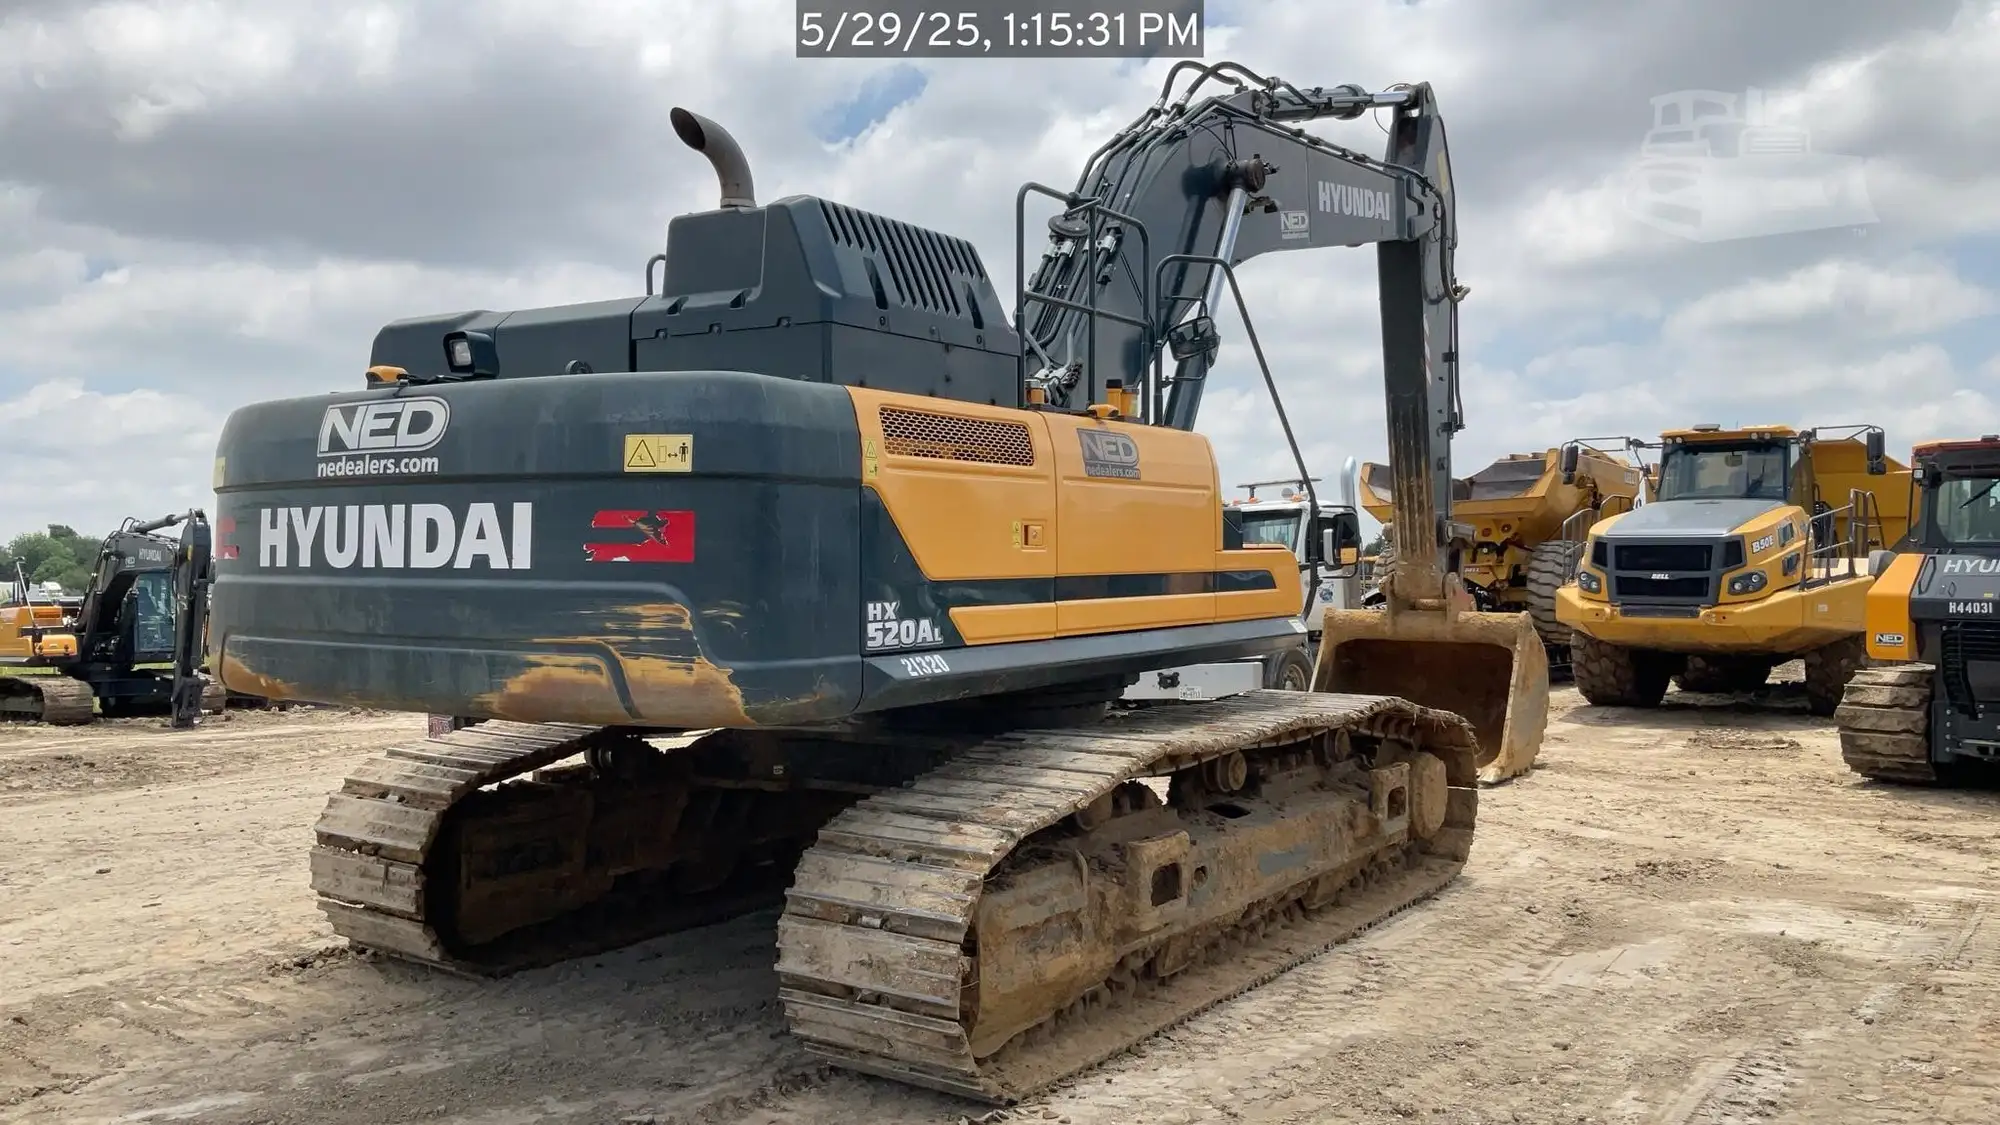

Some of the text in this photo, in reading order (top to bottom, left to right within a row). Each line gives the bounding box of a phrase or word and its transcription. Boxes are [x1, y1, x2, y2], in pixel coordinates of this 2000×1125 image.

[1318, 181, 1390, 221] HYUNDAI
[1280, 211, 1309, 232] NED
[319, 398, 449, 456] NED
[1079, 432, 1138, 463] NED
[316, 455, 439, 478] nedealers.com
[1086, 465, 1138, 478] nedealers.com
[259, 502, 533, 570] HYUNDAI
[1752, 534, 1774, 553] B50E
[1943, 559, 2000, 573] HYU
[867, 601, 898, 621] HX
[866, 618, 943, 648] 520AL
[1875, 633, 1905, 645] NED
[900, 654, 950, 677] 21320
